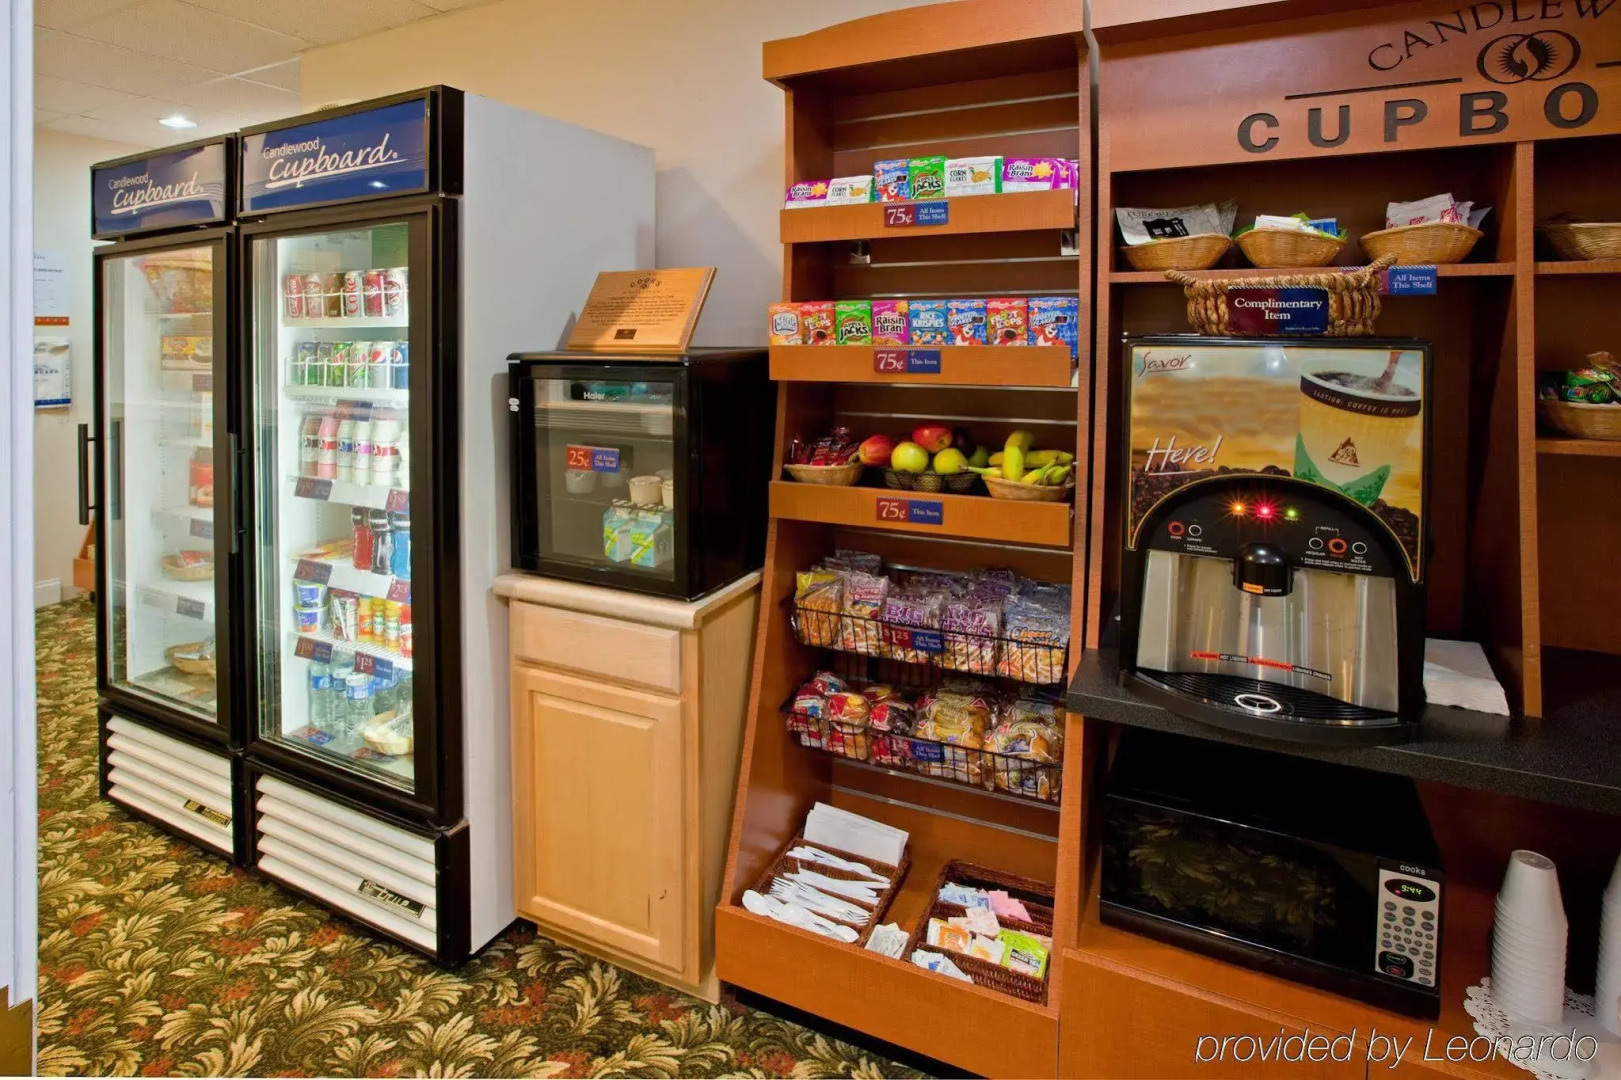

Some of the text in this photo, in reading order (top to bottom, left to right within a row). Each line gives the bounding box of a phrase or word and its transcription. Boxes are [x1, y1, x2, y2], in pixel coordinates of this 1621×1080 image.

[1237, 82, 1599, 153] CUPBO
[263, 137, 320, 160] Candlewood
[269, 133, 393, 188] Cupboard
[1008, 164, 1033, 172] Raisin
[108, 172, 149, 190] Candlewood
[911, 180, 941, 199] JACKS
[113, 171, 198, 215] Cupboard
[887, 208, 913, 225] 75¢
[1234, 297, 1323, 310] Complimentary
[876, 316, 905, 326] Raisin
[912, 318, 945, 328] KRISPIES
[1264, 310, 1291, 320] Item
[840, 326, 869, 343] JACKS
[879, 324, 903, 333] Bran
[877, 353, 904, 370] 75¢
[1138, 351, 1192, 377] Savor
[583, 391, 605, 400] Haier
[568, 450, 589, 467] 25¢
[1145, 435, 1224, 473] Here!
[879, 501, 906, 519] 75¢
[1400, 864, 1426, 876] cooks
